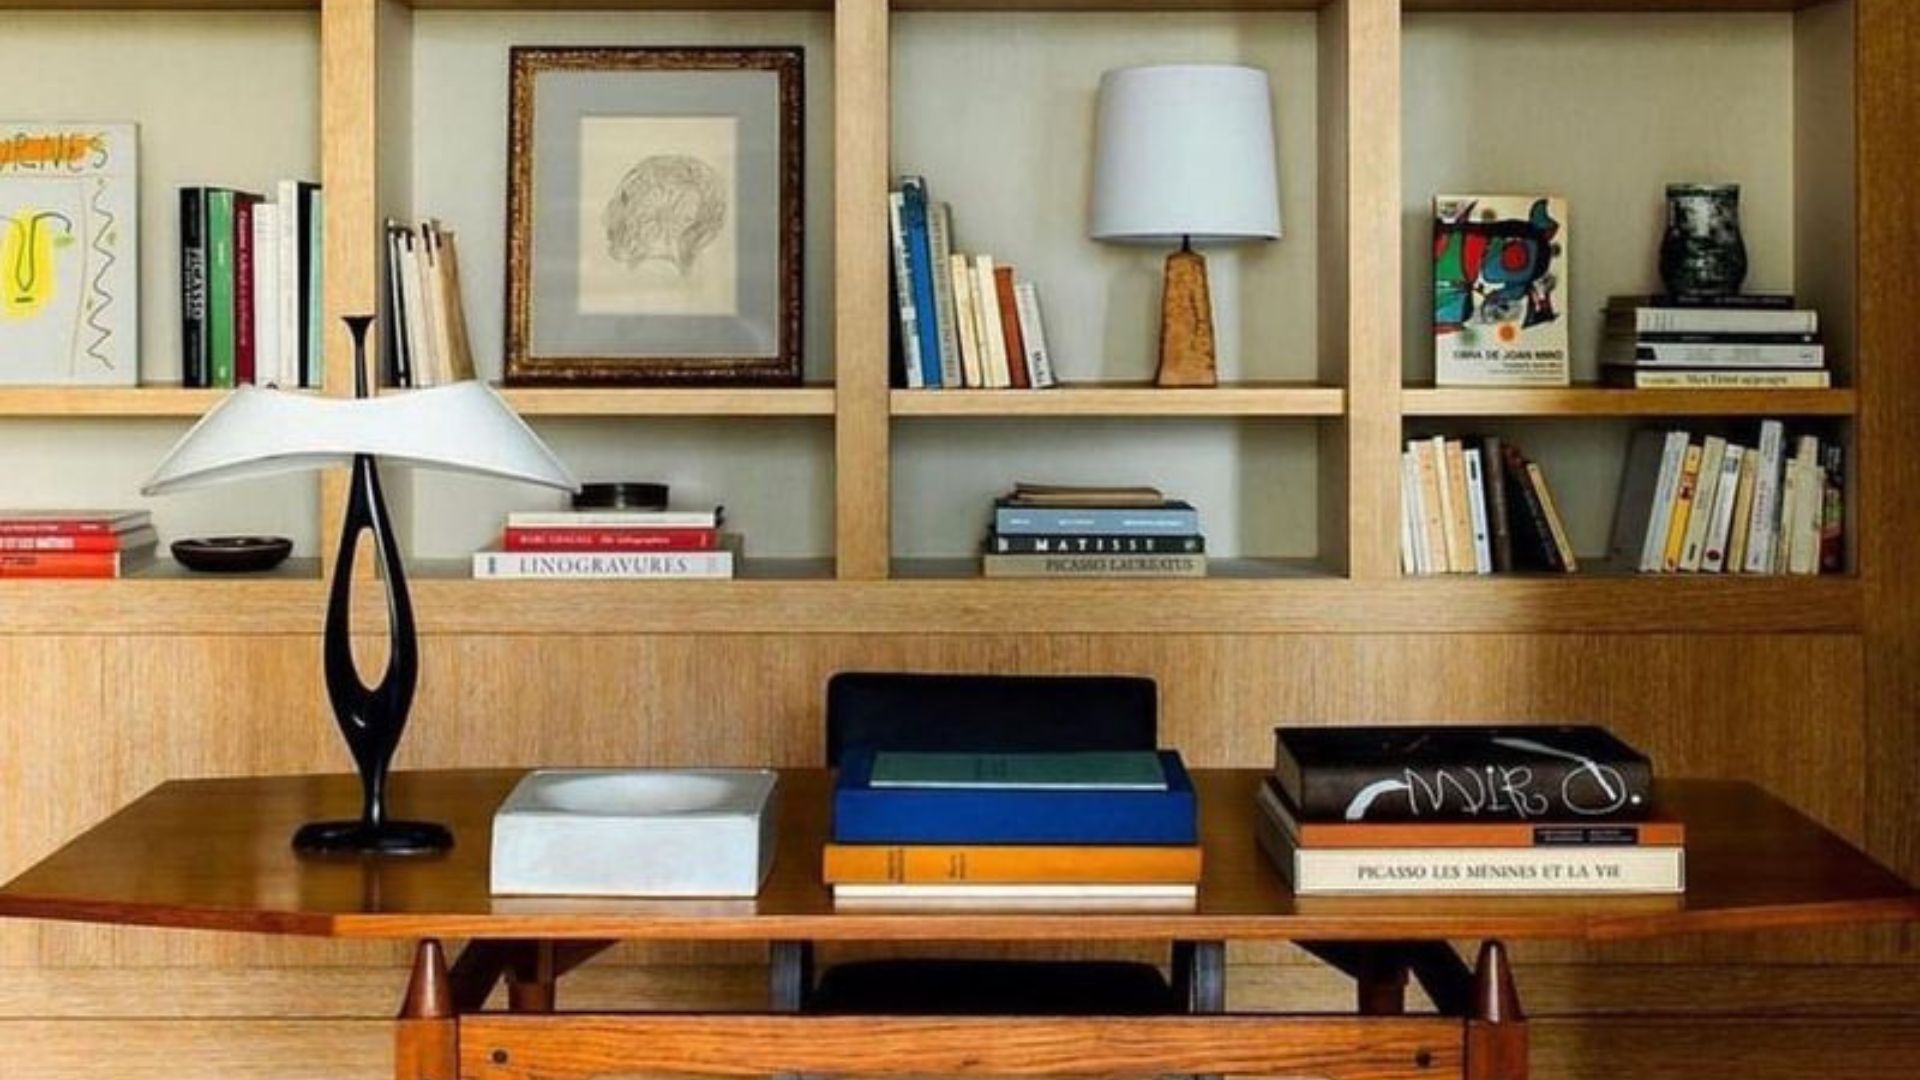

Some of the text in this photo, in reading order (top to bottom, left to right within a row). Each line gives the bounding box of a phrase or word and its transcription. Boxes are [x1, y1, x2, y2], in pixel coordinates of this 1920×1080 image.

[191, 247, 206, 320] PICASSO
[1485, 350, 1499, 359] DE
[1035, 538, 1154, 552] MATISSE
[519, 556, 688, 575] LINOGRAVURES
[1046, 558, 1195, 572] PICASSO LAUREATUS
[1357, 864, 1426, 880] PICASSO
[1432, 864, 1461, 880] LES
[1542, 864, 1563, 880] ET
[1567, 864, 1589, 880] LA
[1595, 864, 1621, 880] VIE
